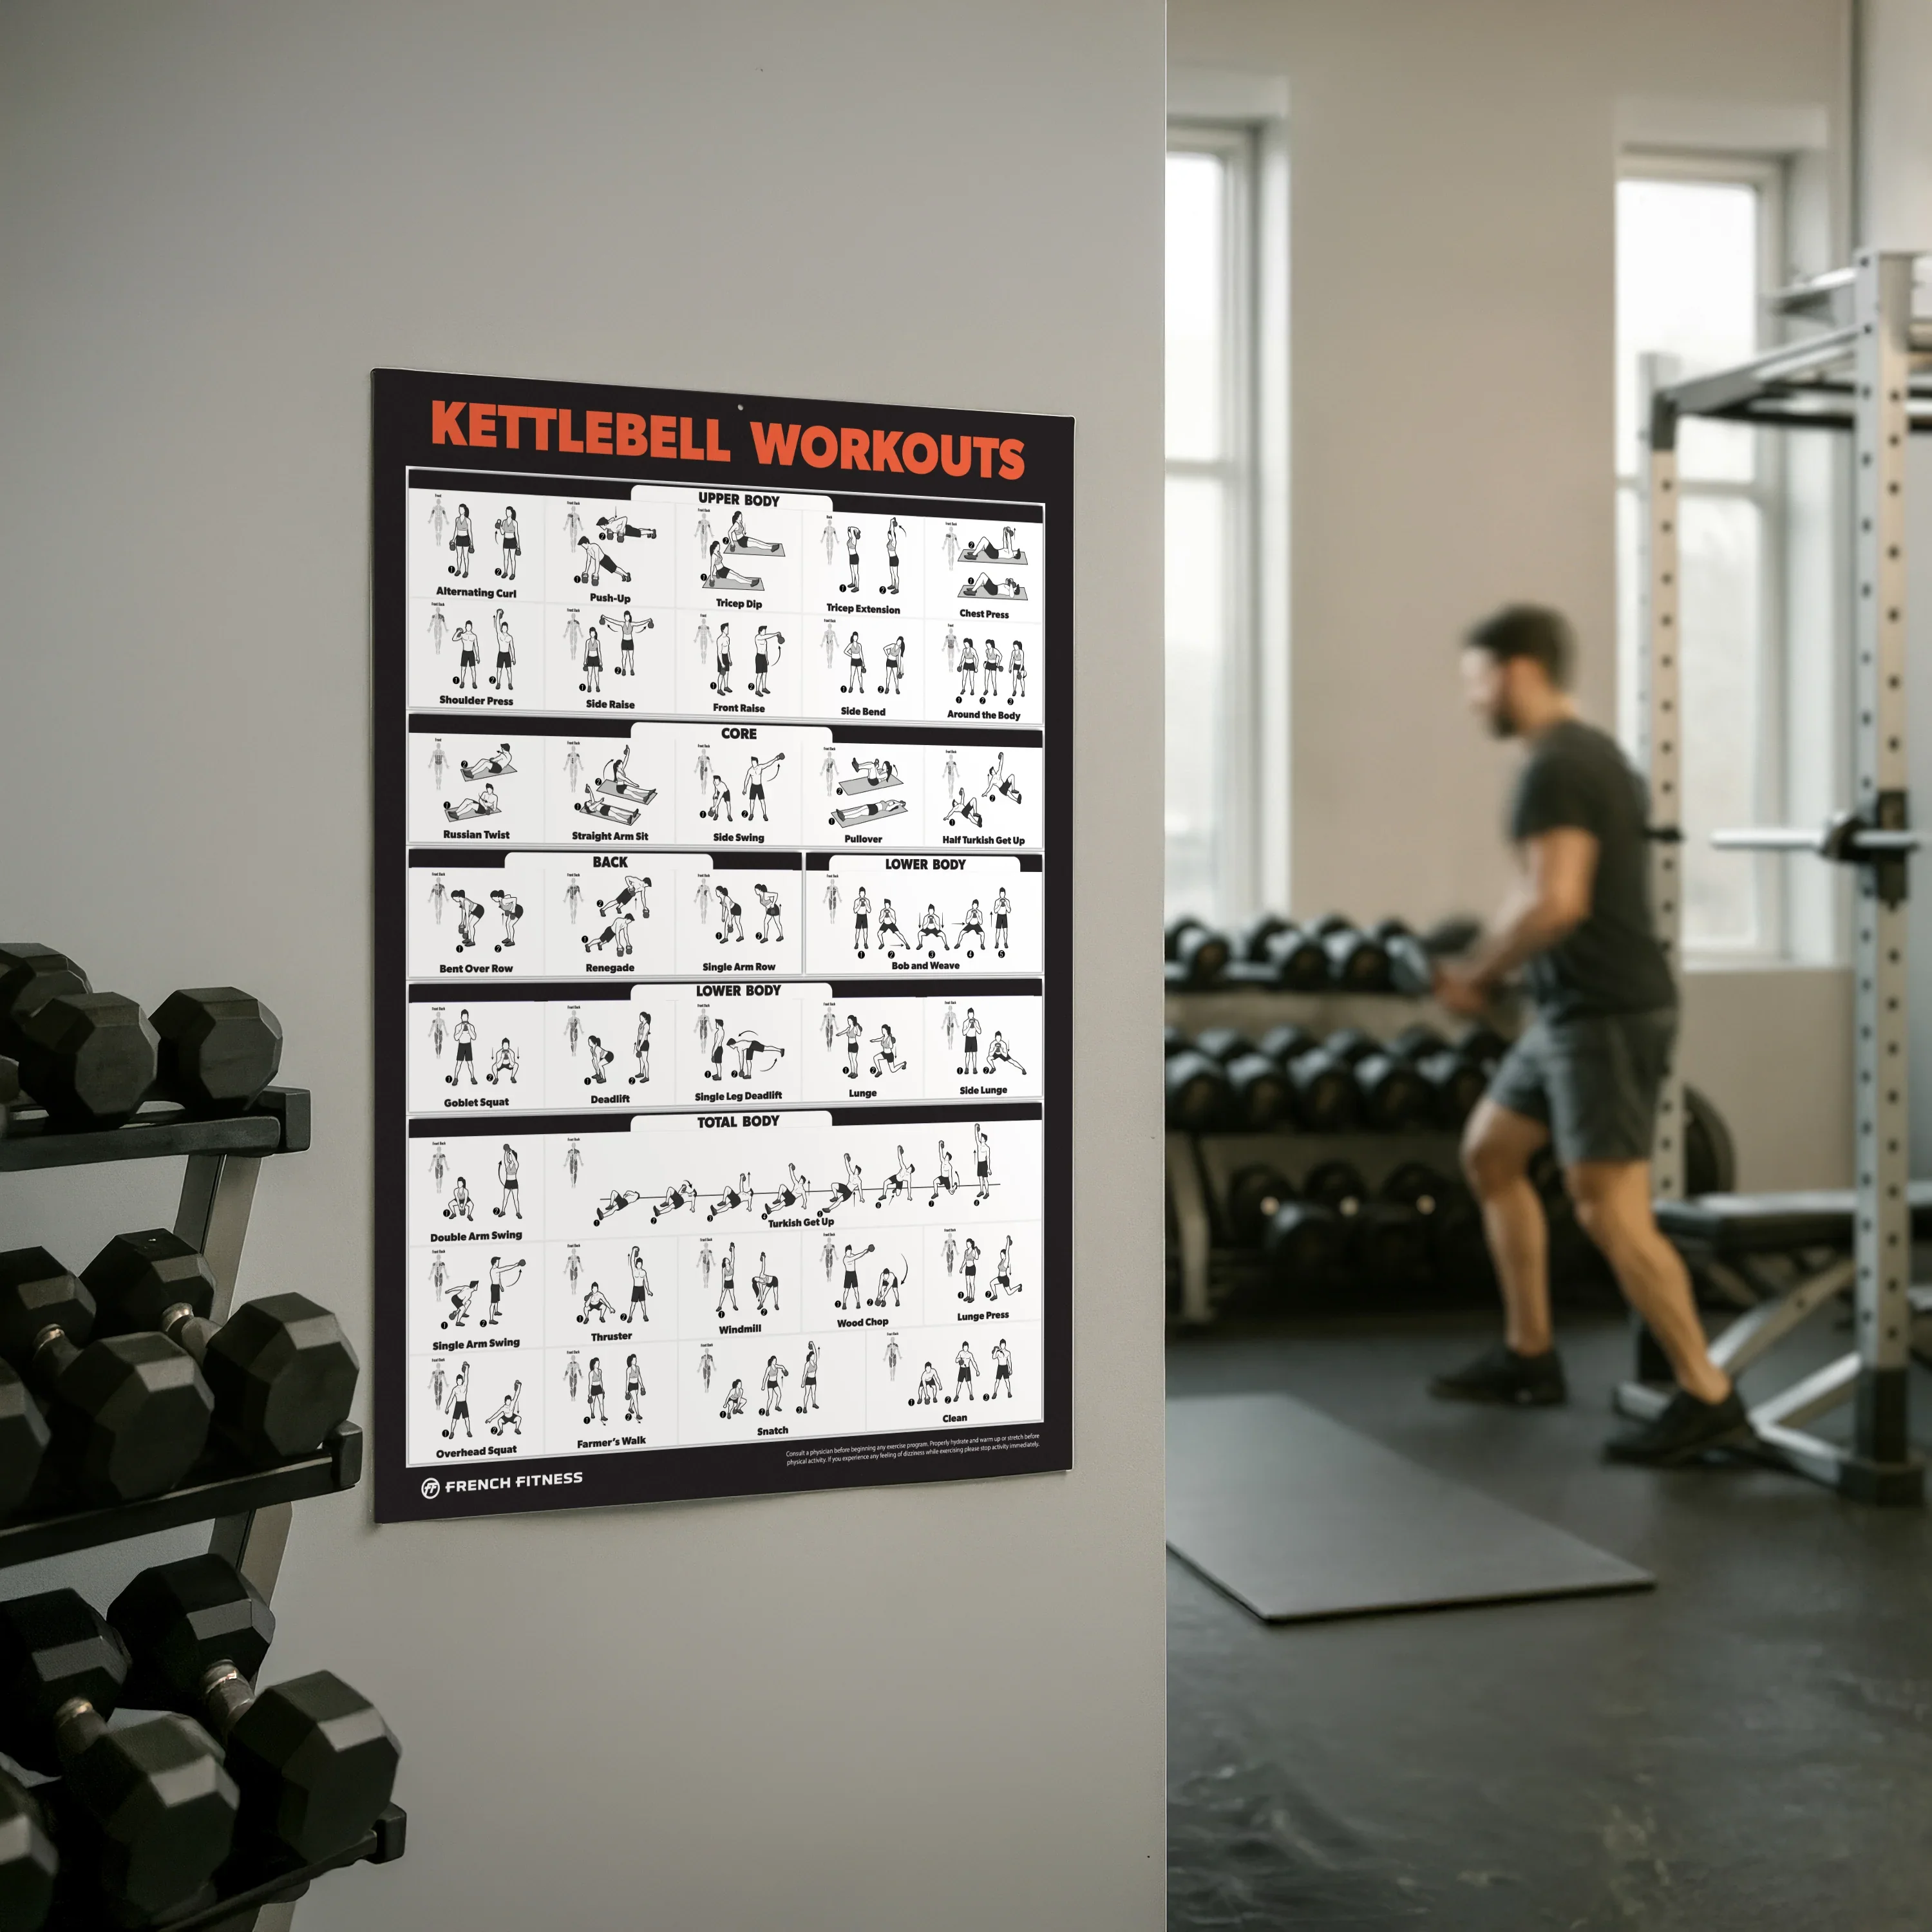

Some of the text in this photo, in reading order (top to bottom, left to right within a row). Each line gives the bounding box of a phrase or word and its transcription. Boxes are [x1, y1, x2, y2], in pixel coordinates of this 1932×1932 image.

[432, 401, 1025, 480] KETTLEBELL WORKOUTS
[699, 492, 780, 507] UPPER BODY
[437, 587, 516, 599] Alternating Curl
[591, 593, 630, 604] Push-Up
[716, 599, 762, 610] Tricep Dip
[827, 603, 900, 614] Tricep Extension
[960, 609, 984, 618] Chest
[440, 696, 513, 705] Shoulder Press
[587, 699, 635, 708] Side Raise
[714, 703, 765, 712] Front Raise
[998, 712, 1021, 721] Body
[722, 728, 757, 739] CORE
[444, 830, 509, 838] Russian Twist
[573, 831, 612, 842] Straight
[636, 832, 649, 840] Sit
[714, 833, 764, 843] Side Swing
[1013, 837, 1025, 846] Up
[594, 857, 628, 867] BACK
[886, 859, 966, 869] LOWER BODY
[586, 963, 634, 973] Renegade
[703, 963, 732, 972] Single
[697, 985, 781, 996] LOWER BODY
[849, 1090, 876, 1098] Lunge
[981, 1086, 1007, 1095] Lunge
[591, 1094, 630, 1103] Deadlift
[696, 1091, 782, 1103] Single Leg Deadlift
[444, 1098, 509, 1108] Goblet Squat
[697, 1115, 780, 1128] TOTAL BODY
[768, 1218, 801, 1227] Turkish
[822, 1218, 834, 1227] Up
[431, 1233, 466, 1242] Double
[491, 1230, 522, 1240] Swing
[958, 1313, 984, 1321] Lunge
[837, 1318, 889, 1327] Wood Chop
[719, 1324, 761, 1334] Windmill
[591, 1332, 632, 1341] Thruster
[433, 1338, 520, 1351] Single Arm Swing
[757, 1426, 788, 1435] Snatch
[622, 1436, 646, 1445] Walk
[437, 1446, 516, 1458] Overhead Squat
[787, 1458, 807, 1466] physical
[446, 1477, 510, 1492] FRENCH
[516, 1472, 582, 1487] FITNESS
